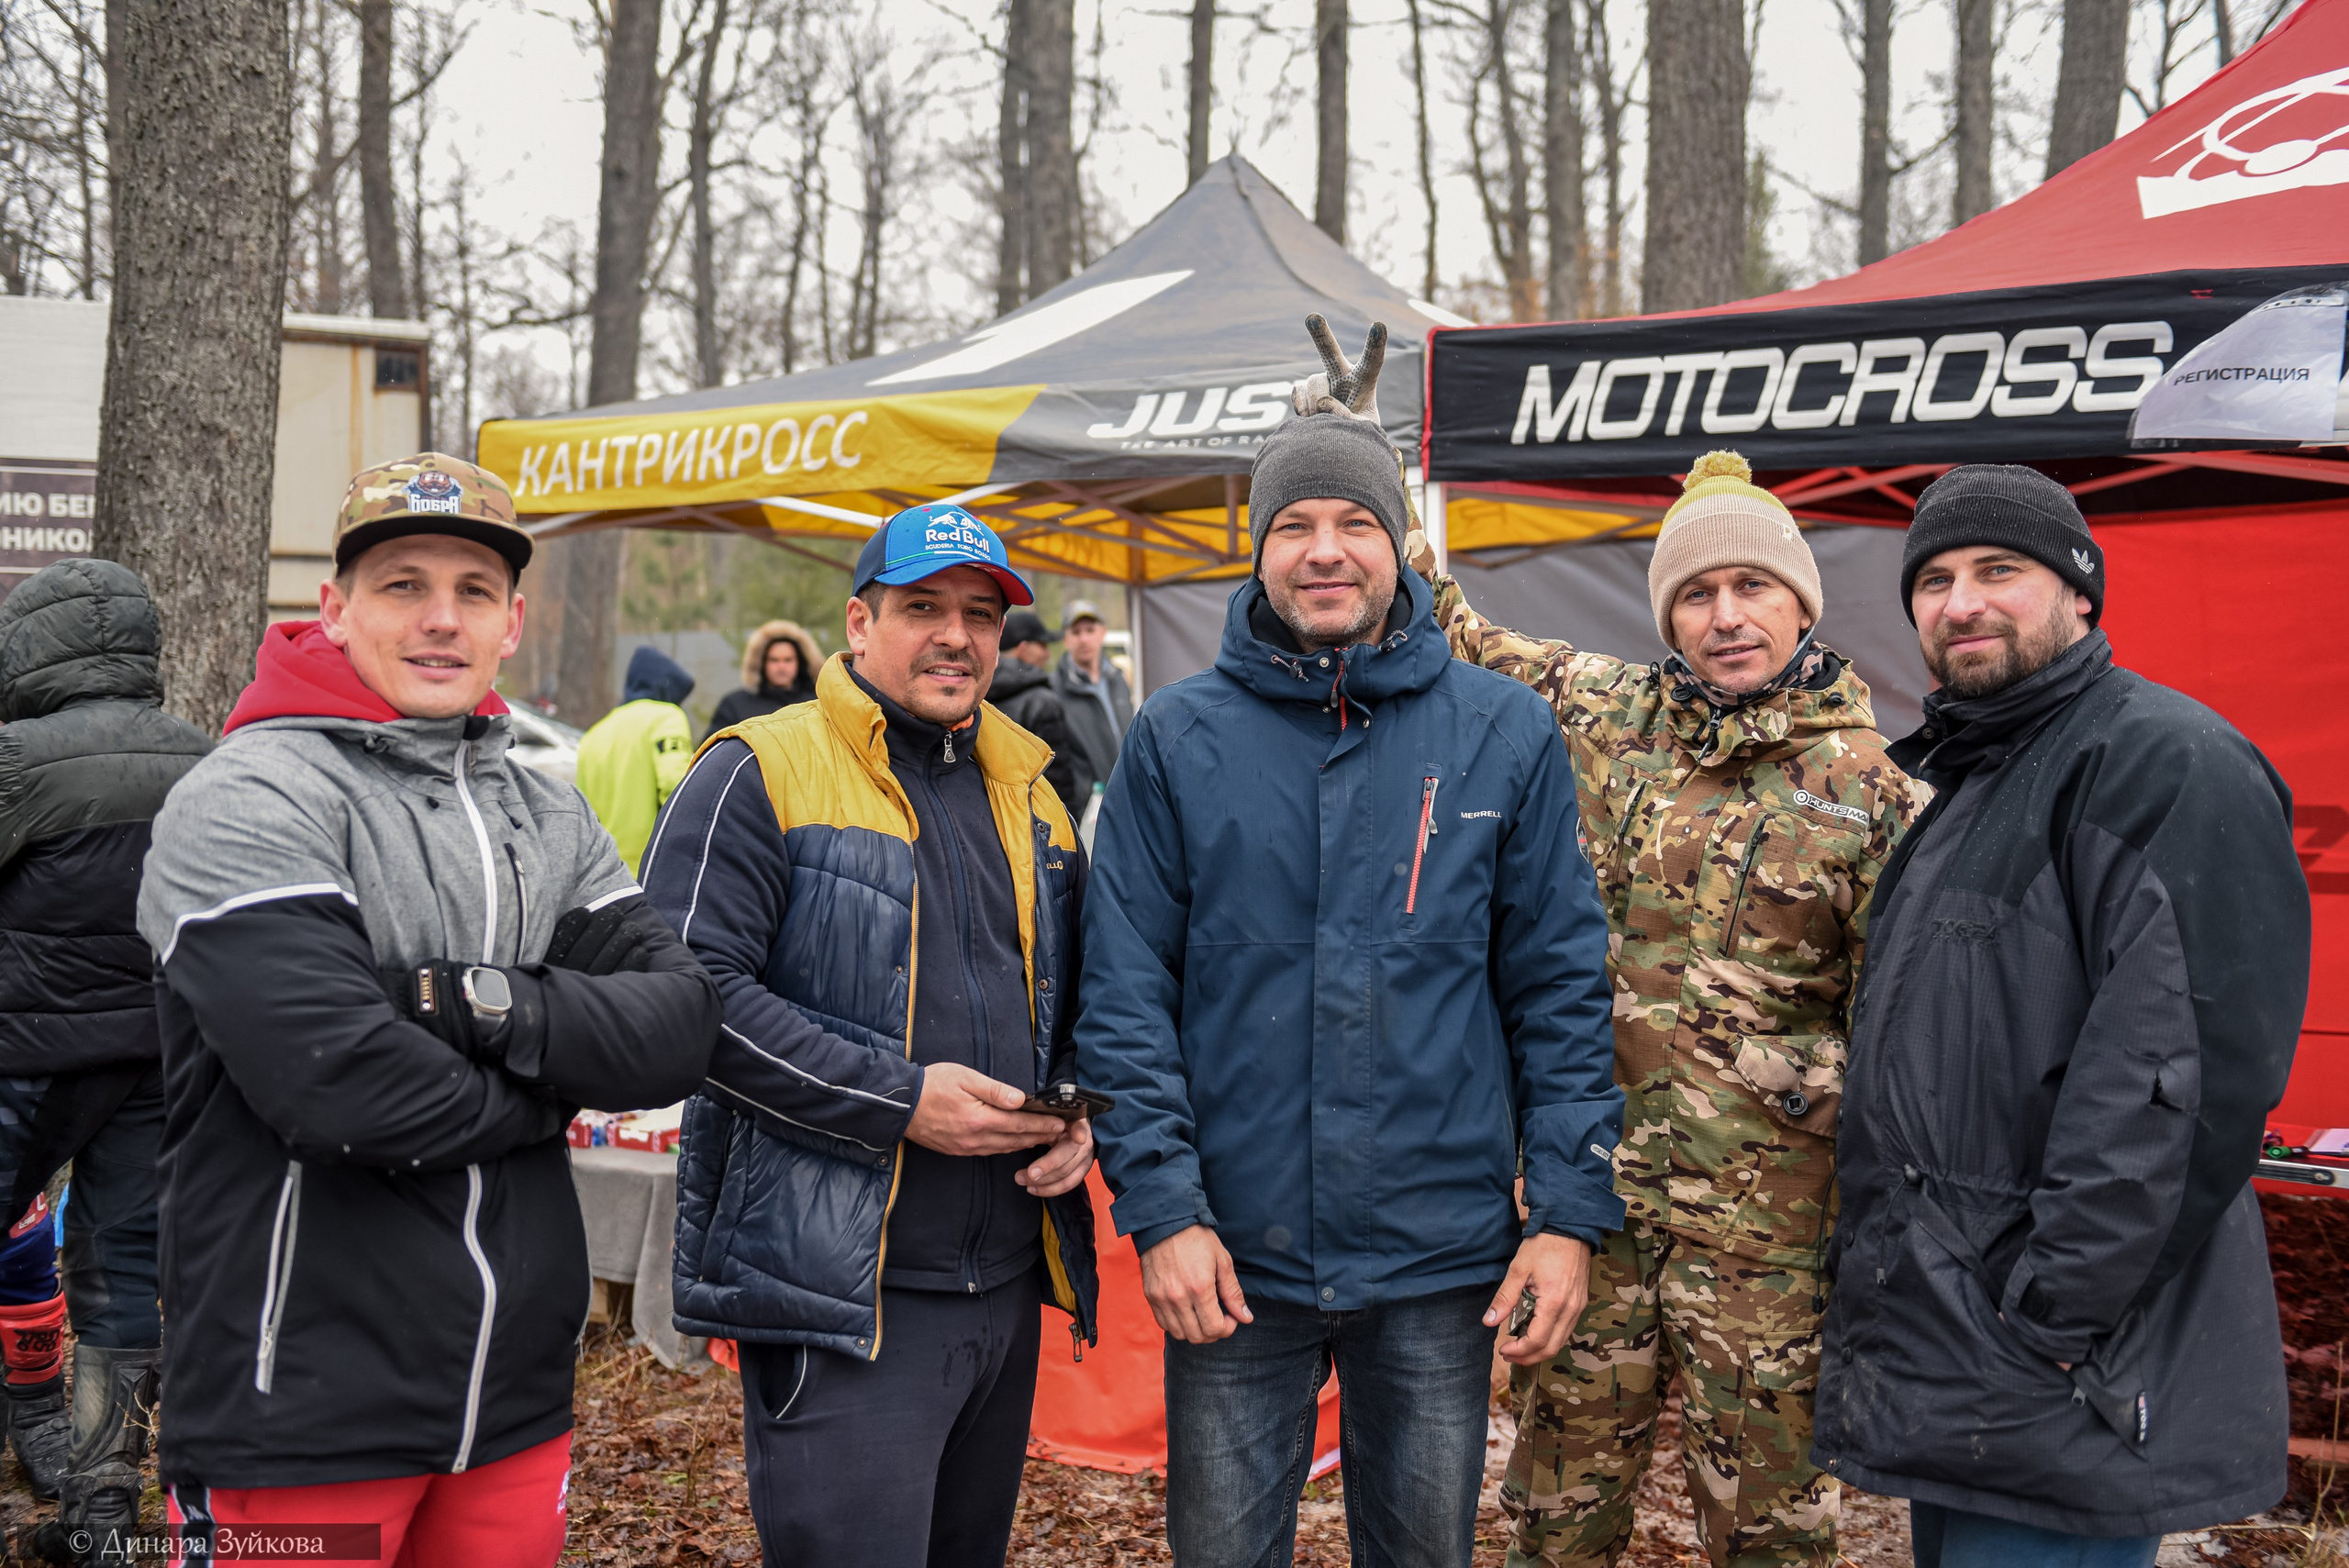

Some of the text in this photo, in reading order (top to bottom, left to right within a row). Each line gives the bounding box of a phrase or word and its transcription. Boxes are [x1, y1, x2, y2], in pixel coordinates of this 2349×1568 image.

[1511, 321, 2173, 444] MOTOCROSS
[2174, 367, 2310, 385] РЕГИСТРАЦИЯ
[1086, 379, 1308, 439] JUS
[514, 410, 868, 497] КАНТРИКРОСС
[1120, 440, 1155, 450] THE
[1163, 438, 1202, 449] ART
[1208, 436, 1233, 446] OF
[49, 493, 95, 518] БЕ
[0, 526, 94, 552] НИКО
[925, 528, 990, 553] Red Bull
[957, 544, 973, 552] TORO
[1461, 811, 1502, 819] MERRELL
